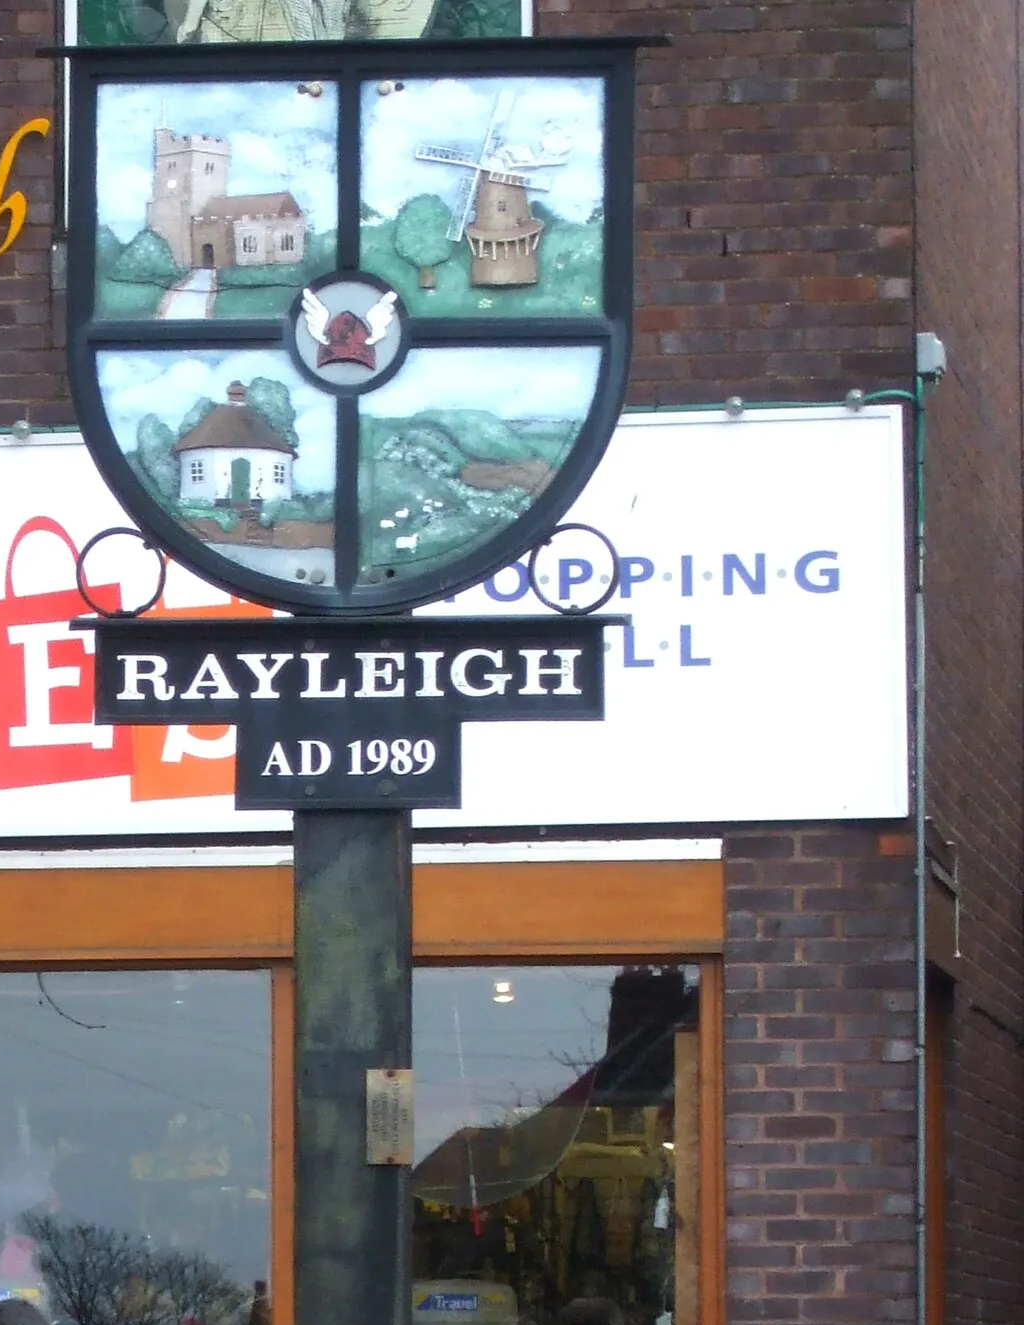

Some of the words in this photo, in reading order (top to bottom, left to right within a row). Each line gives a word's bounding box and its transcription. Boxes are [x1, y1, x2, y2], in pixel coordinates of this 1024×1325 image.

[115, 648, 583, 701] RAYLEIGH
[261, 741, 332, 777] AD
[346, 738, 436, 777] 1989
[435, 1295, 478, 1309] Travel
